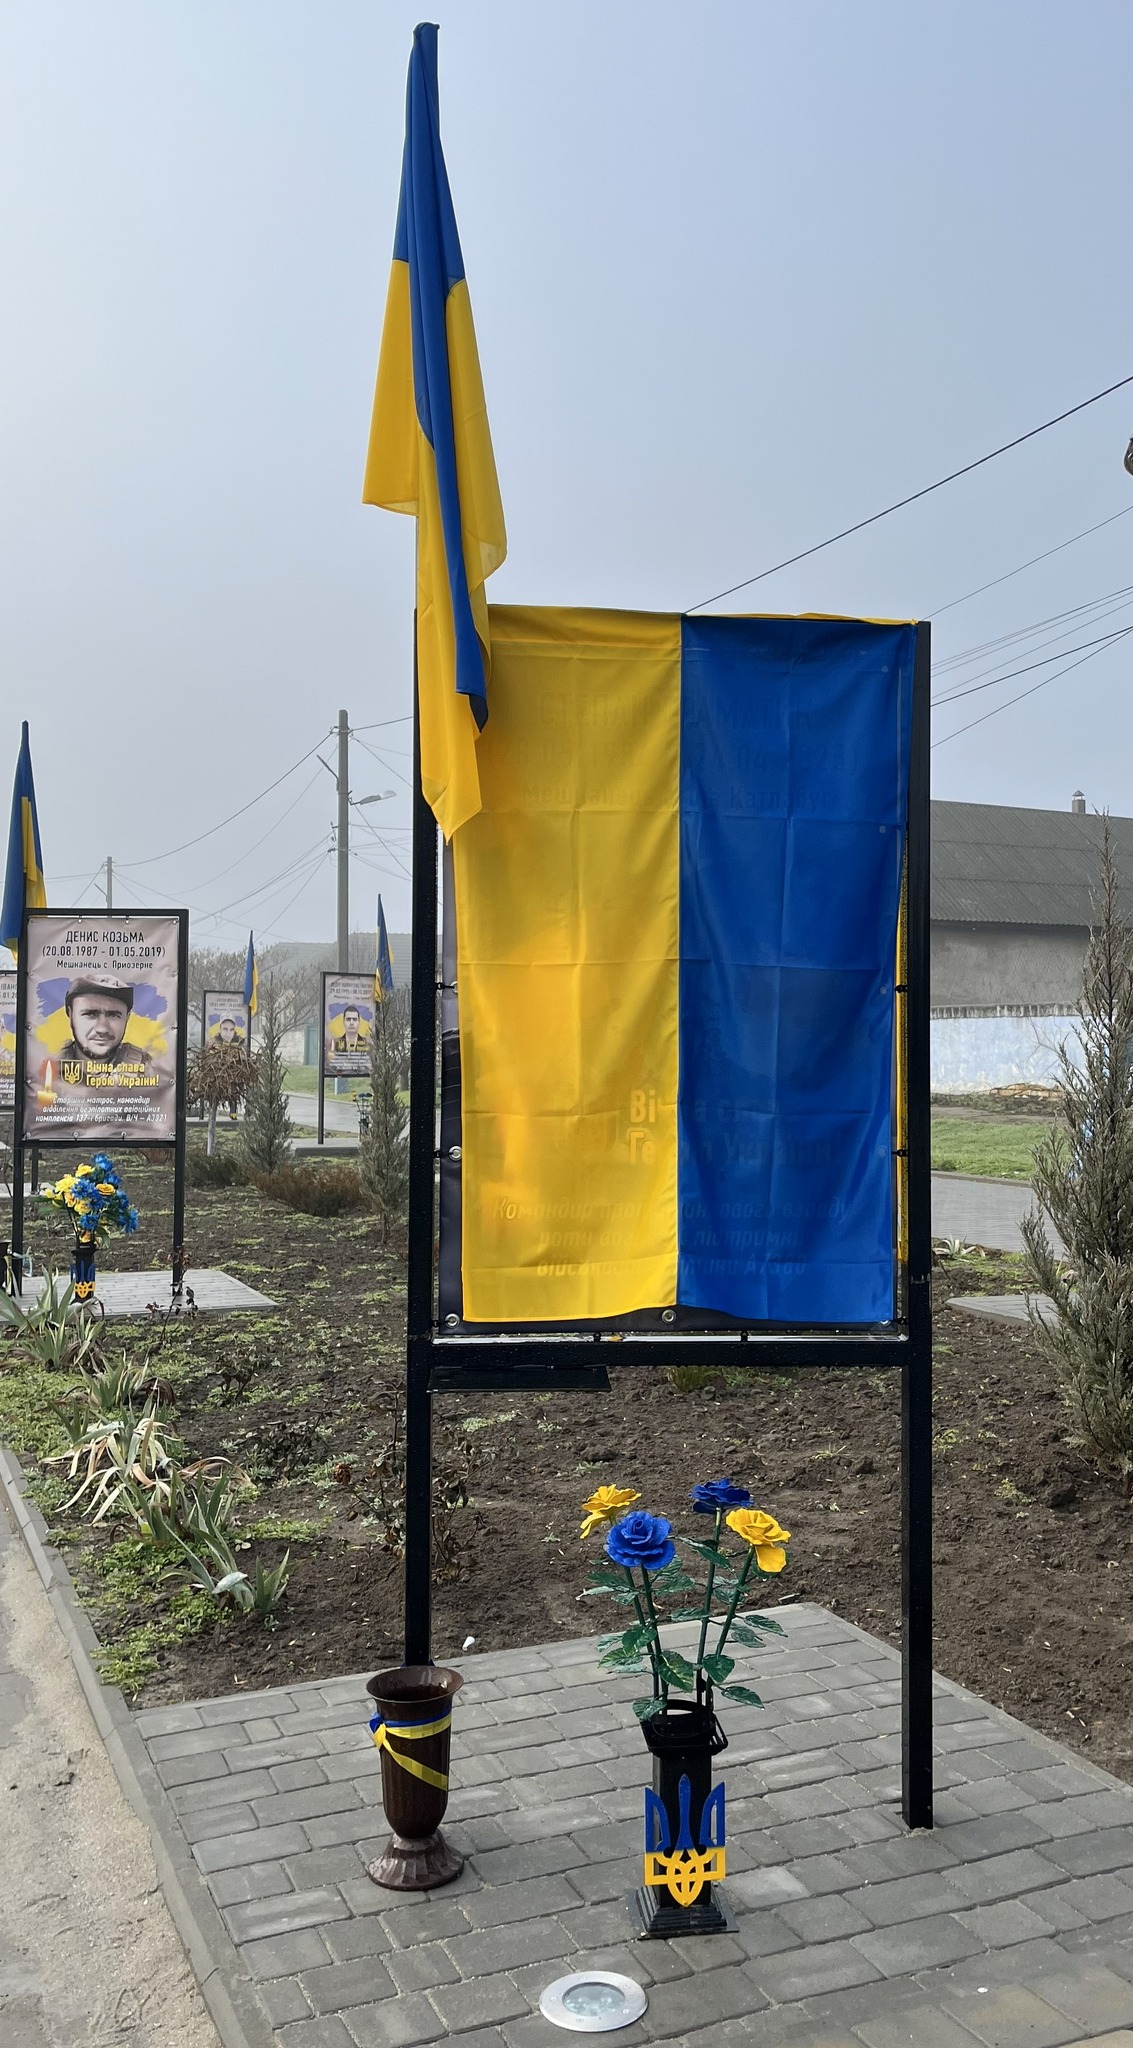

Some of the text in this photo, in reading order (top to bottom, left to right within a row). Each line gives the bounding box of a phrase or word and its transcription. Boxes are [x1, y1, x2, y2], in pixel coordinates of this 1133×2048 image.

[65, 930, 145, 944] ДЕНИС КОЗЬМА
[42, 946, 98, 957] (20.08.1987
[109, 946, 166, 957] 01.05.2019)
[56, 959, 102, 969] Мешканець
[112, 960, 153, 970] Приозерне
[86, 1061, 145, 1073] Вічна слава
[86, 1075, 160, 1089] Герою України!
[117, 1095, 151, 1106] командир
